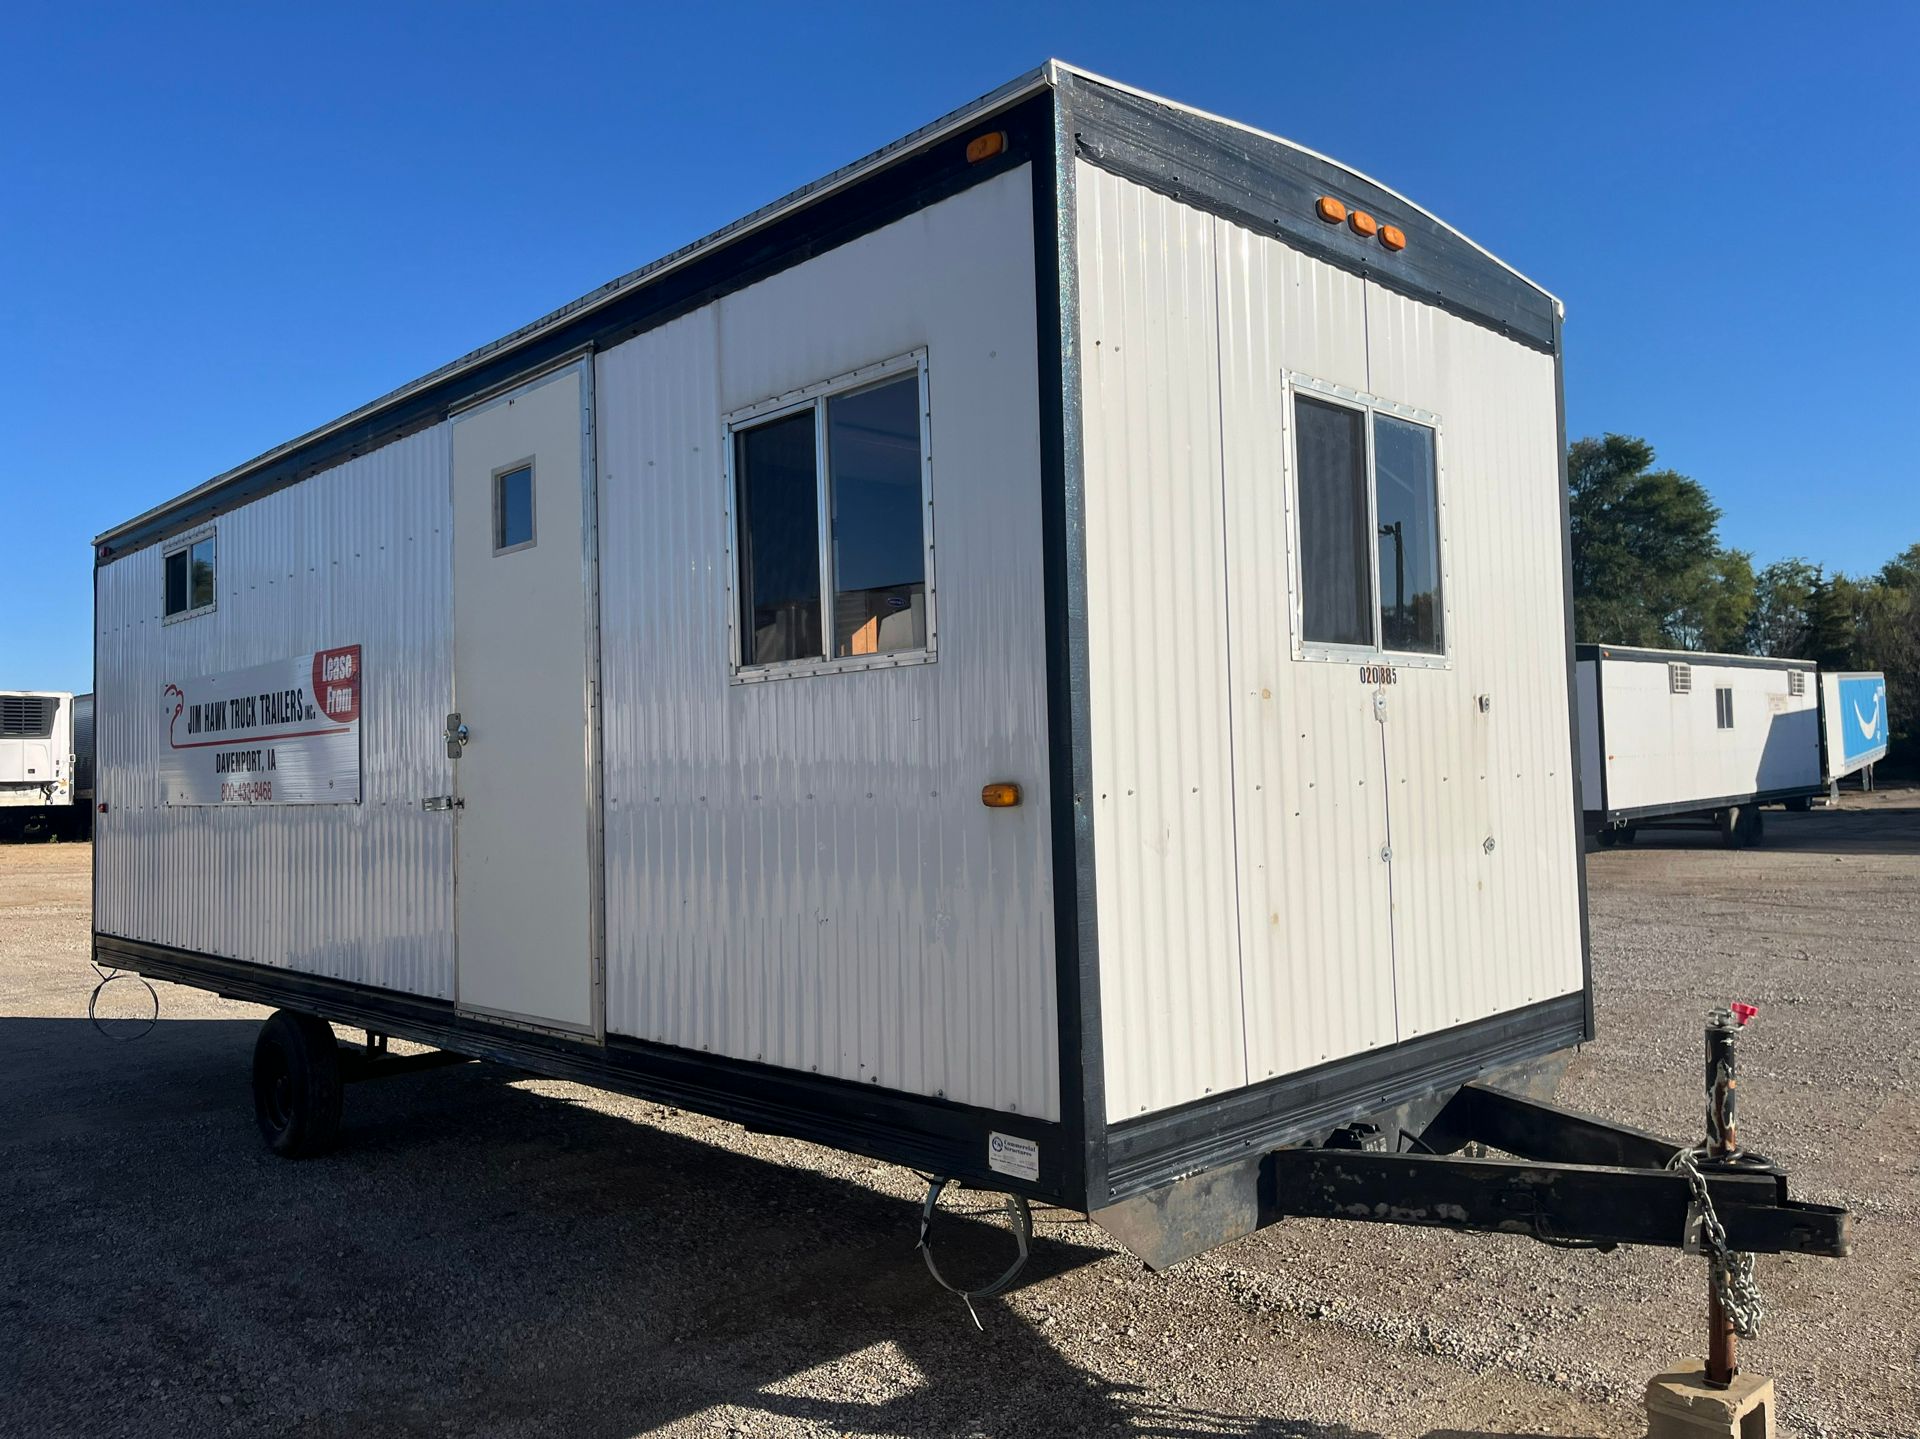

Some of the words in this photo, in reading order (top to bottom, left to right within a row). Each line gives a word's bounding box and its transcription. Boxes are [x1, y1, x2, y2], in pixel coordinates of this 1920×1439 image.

[322, 653, 352, 682] Lease
[1360, 666, 1397, 684] 020885
[187, 704, 202, 735] JIM
[204, 700, 227, 733] HAWK
[230, 695, 257, 729] TRUCK
[260, 688, 303, 725] TRAILERS
[326, 686, 352, 714] From
[216, 750, 264, 774] DAVENPORT,
[267, 749, 277, 771] IA
